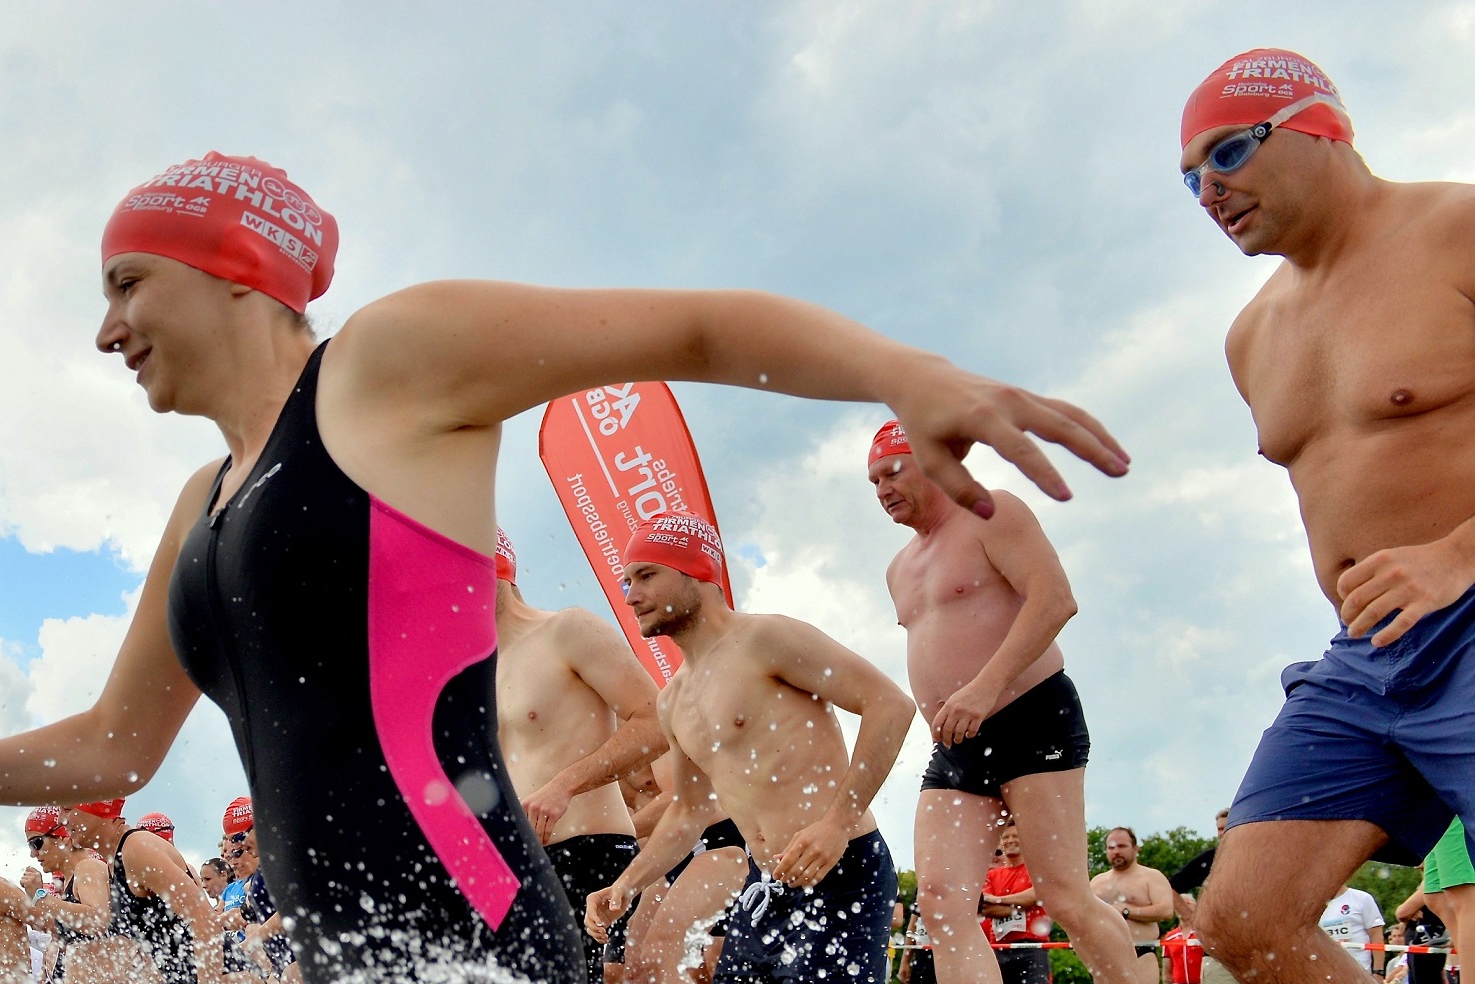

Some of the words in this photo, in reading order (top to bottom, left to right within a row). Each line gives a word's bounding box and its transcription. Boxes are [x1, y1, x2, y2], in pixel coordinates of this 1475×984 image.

[1232, 60, 1313, 75] FIRMEN
[1226, 67, 1340, 96] TRIATHLO
[1222, 85, 1276, 96] Sport
[125, 194, 186, 211] Sport
[189, 196, 211, 207] AK
[143, 173, 323, 247] TRIATHLON
[242, 213, 301, 255] WKS
[656, 518, 706, 532] FIRMEN
[647, 533, 678, 544] Sport
[652, 523, 722, 550] TRIATHLO
